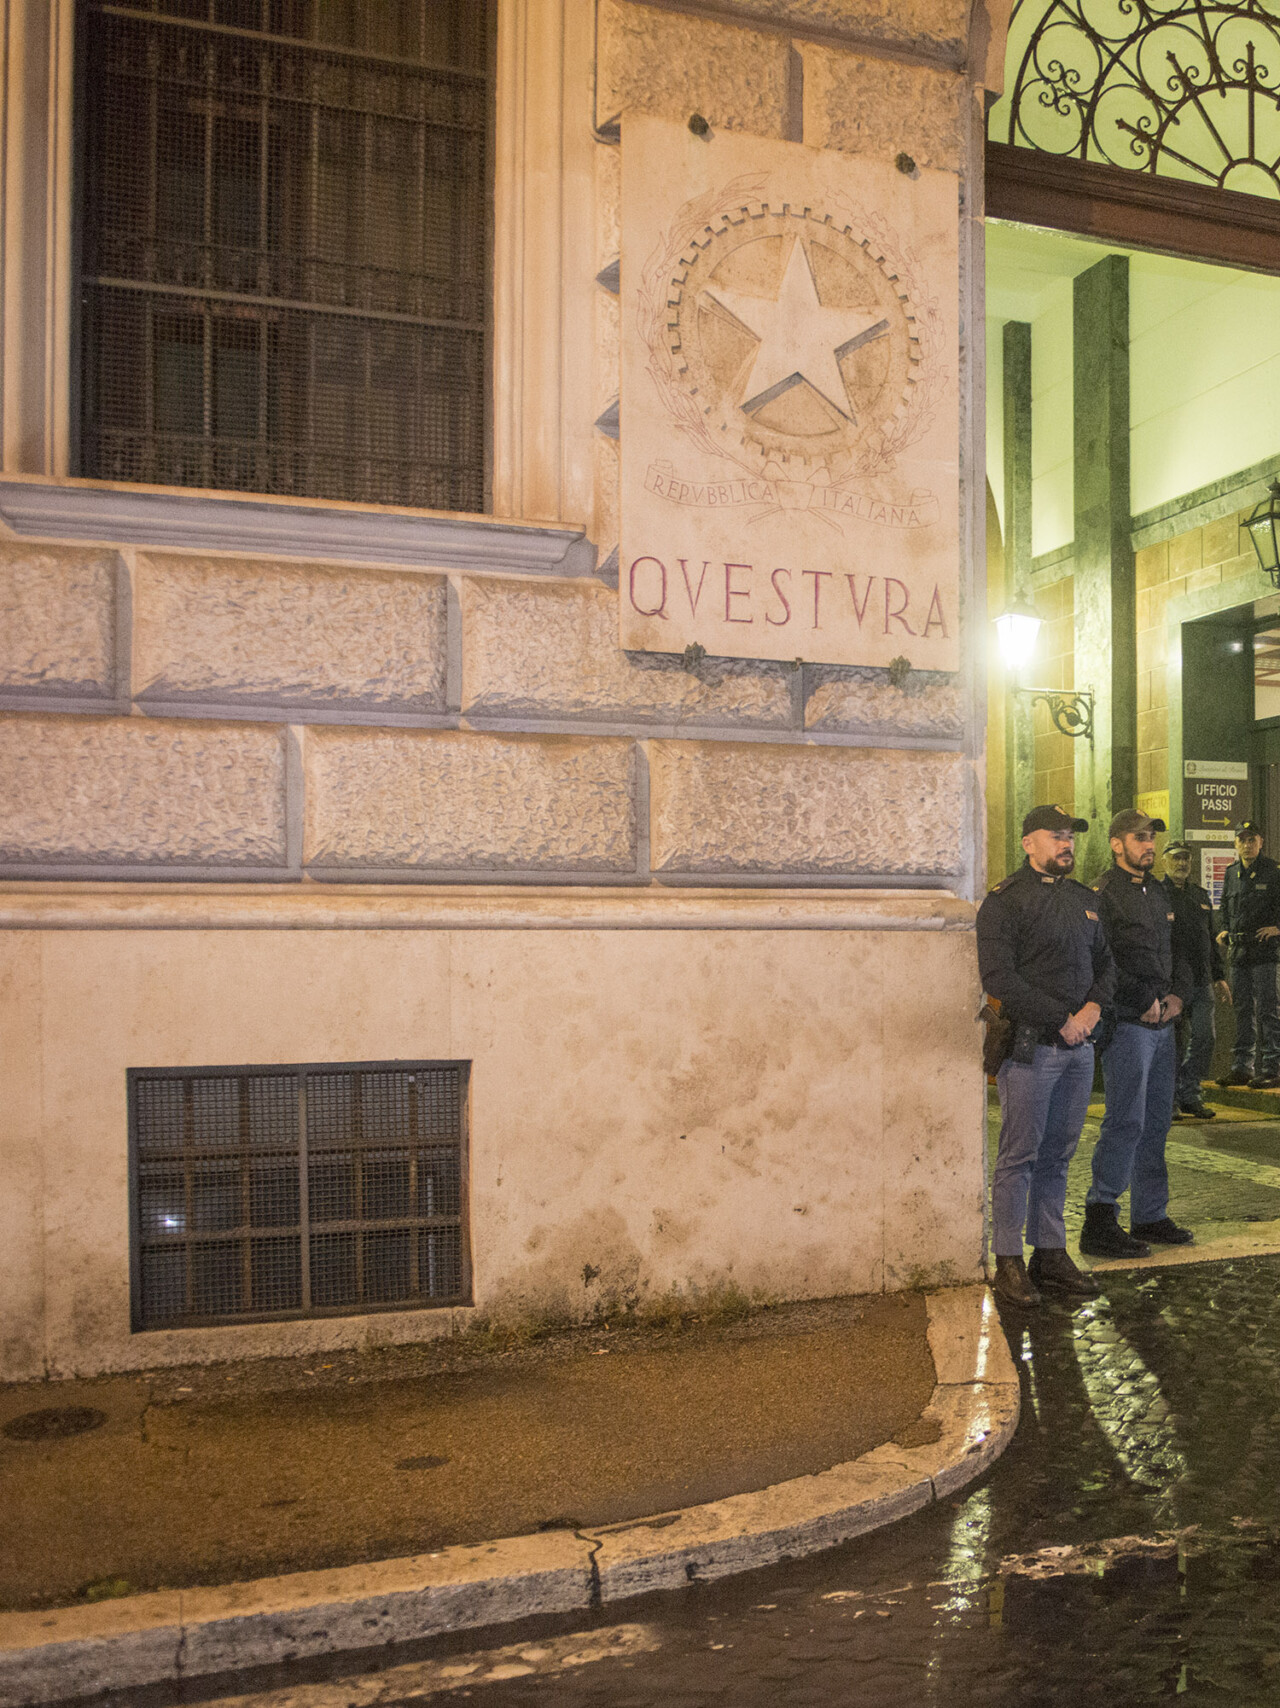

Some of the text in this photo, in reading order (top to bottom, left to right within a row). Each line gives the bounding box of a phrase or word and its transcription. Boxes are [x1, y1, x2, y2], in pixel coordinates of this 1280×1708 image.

[652, 474, 921, 525] REPVBBLICA ITALIANA
[628, 556, 951, 639] QVESTVRA
[1196, 784, 1237, 796] UFFICIO
[1201, 799, 1232, 811] PASSI
